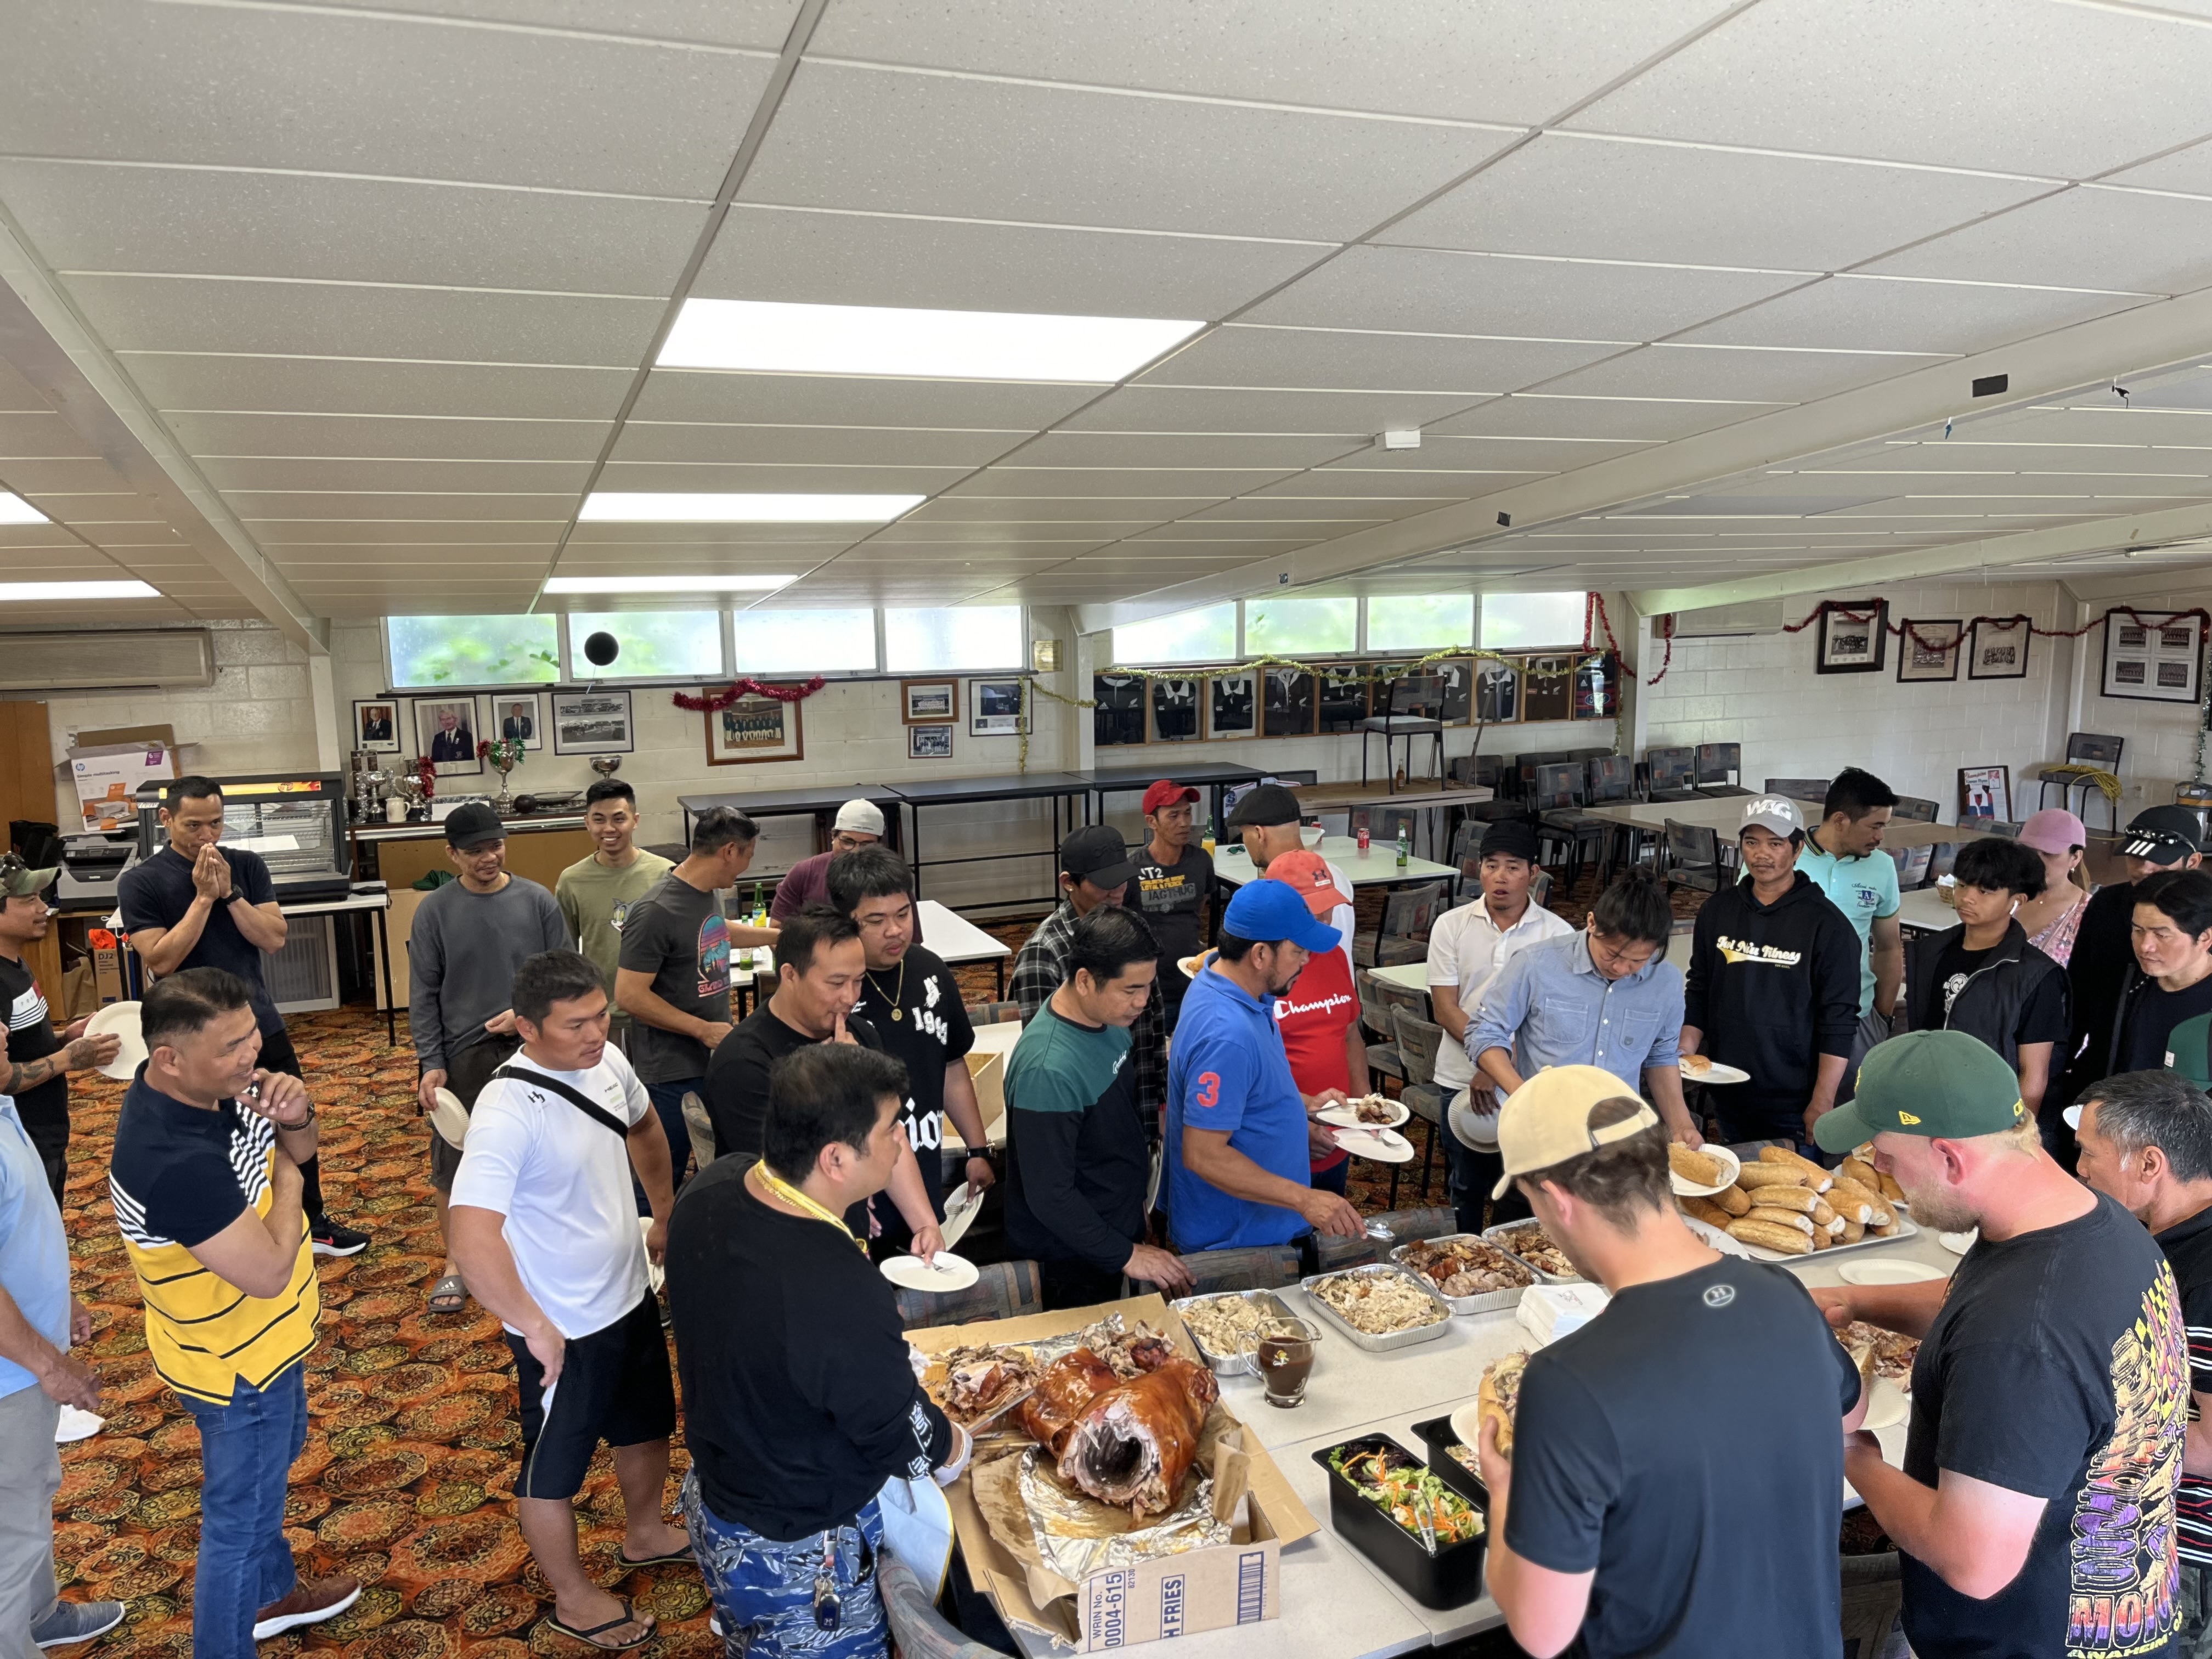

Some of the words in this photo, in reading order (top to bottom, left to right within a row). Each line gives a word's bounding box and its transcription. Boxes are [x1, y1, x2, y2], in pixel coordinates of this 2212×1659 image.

[76, 763, 84, 771] hp
[1273, 993, 1352, 1019] Champion
[1197, 1071, 1221, 1107] 3
[1105, 1573, 1123, 1647] 0004-615
[1164, 1579, 1182, 1624] FRIES
[1092, 1611, 1102, 1639] WRIN
[2066, 1634, 2169, 1659] ANAHEIM
